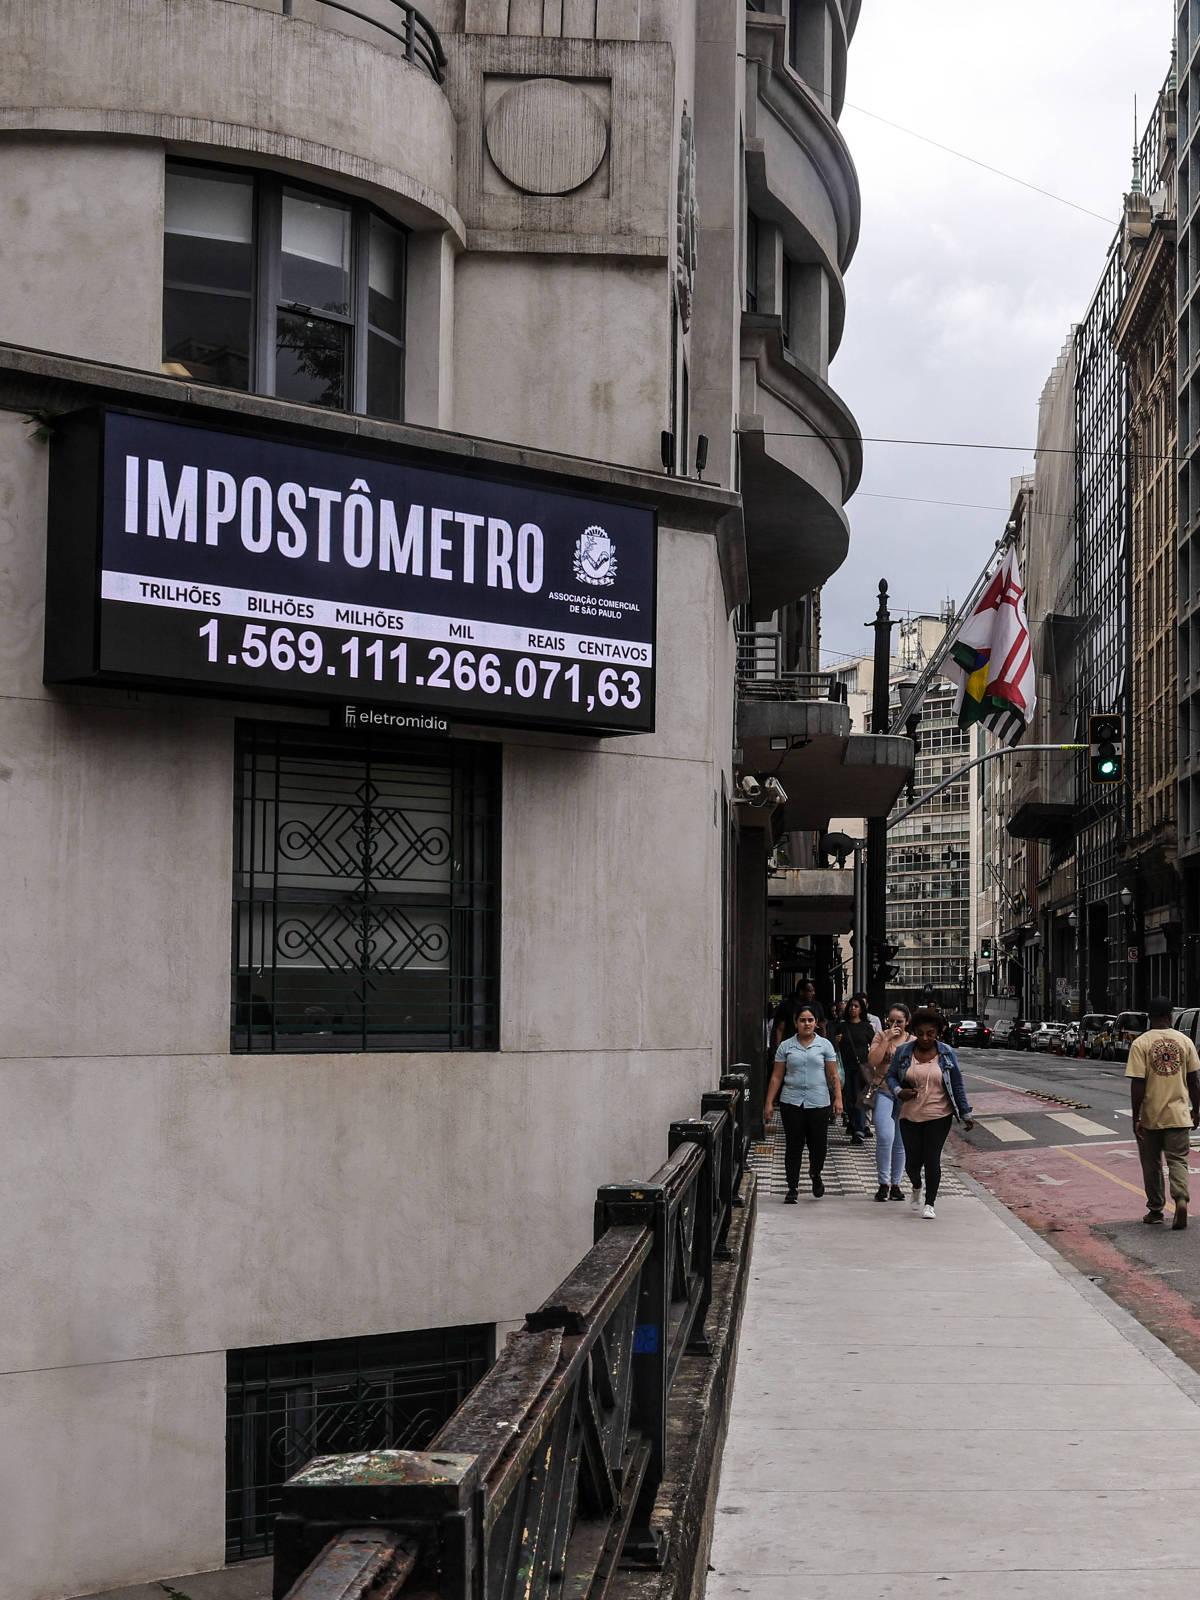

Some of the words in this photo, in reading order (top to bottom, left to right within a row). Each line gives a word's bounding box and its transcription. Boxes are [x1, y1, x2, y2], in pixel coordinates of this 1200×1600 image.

[125, 455, 544, 594] IMPOSTÔMETRO
[139, 581, 221, 607] TRILHÕES
[247, 597, 314, 619] BILHÕES
[335, 609, 404, 631] MILHÕES
[449, 623, 475, 640] MIL
[528, 634, 566, 651] REAIS
[578, 641, 648, 661] CENTAVOS
[549, 592, 597, 606] ASSOCIAÇÃO
[598, 599, 640, 612] COMERCIAL
[569, 605, 579, 613] DE
[581, 606, 597, 616] SÃO
[598, 611, 622, 620] PAULO
[199, 618, 642, 712] 1.569.111.266.071,63
[359, 710, 448, 731] eletromidia
